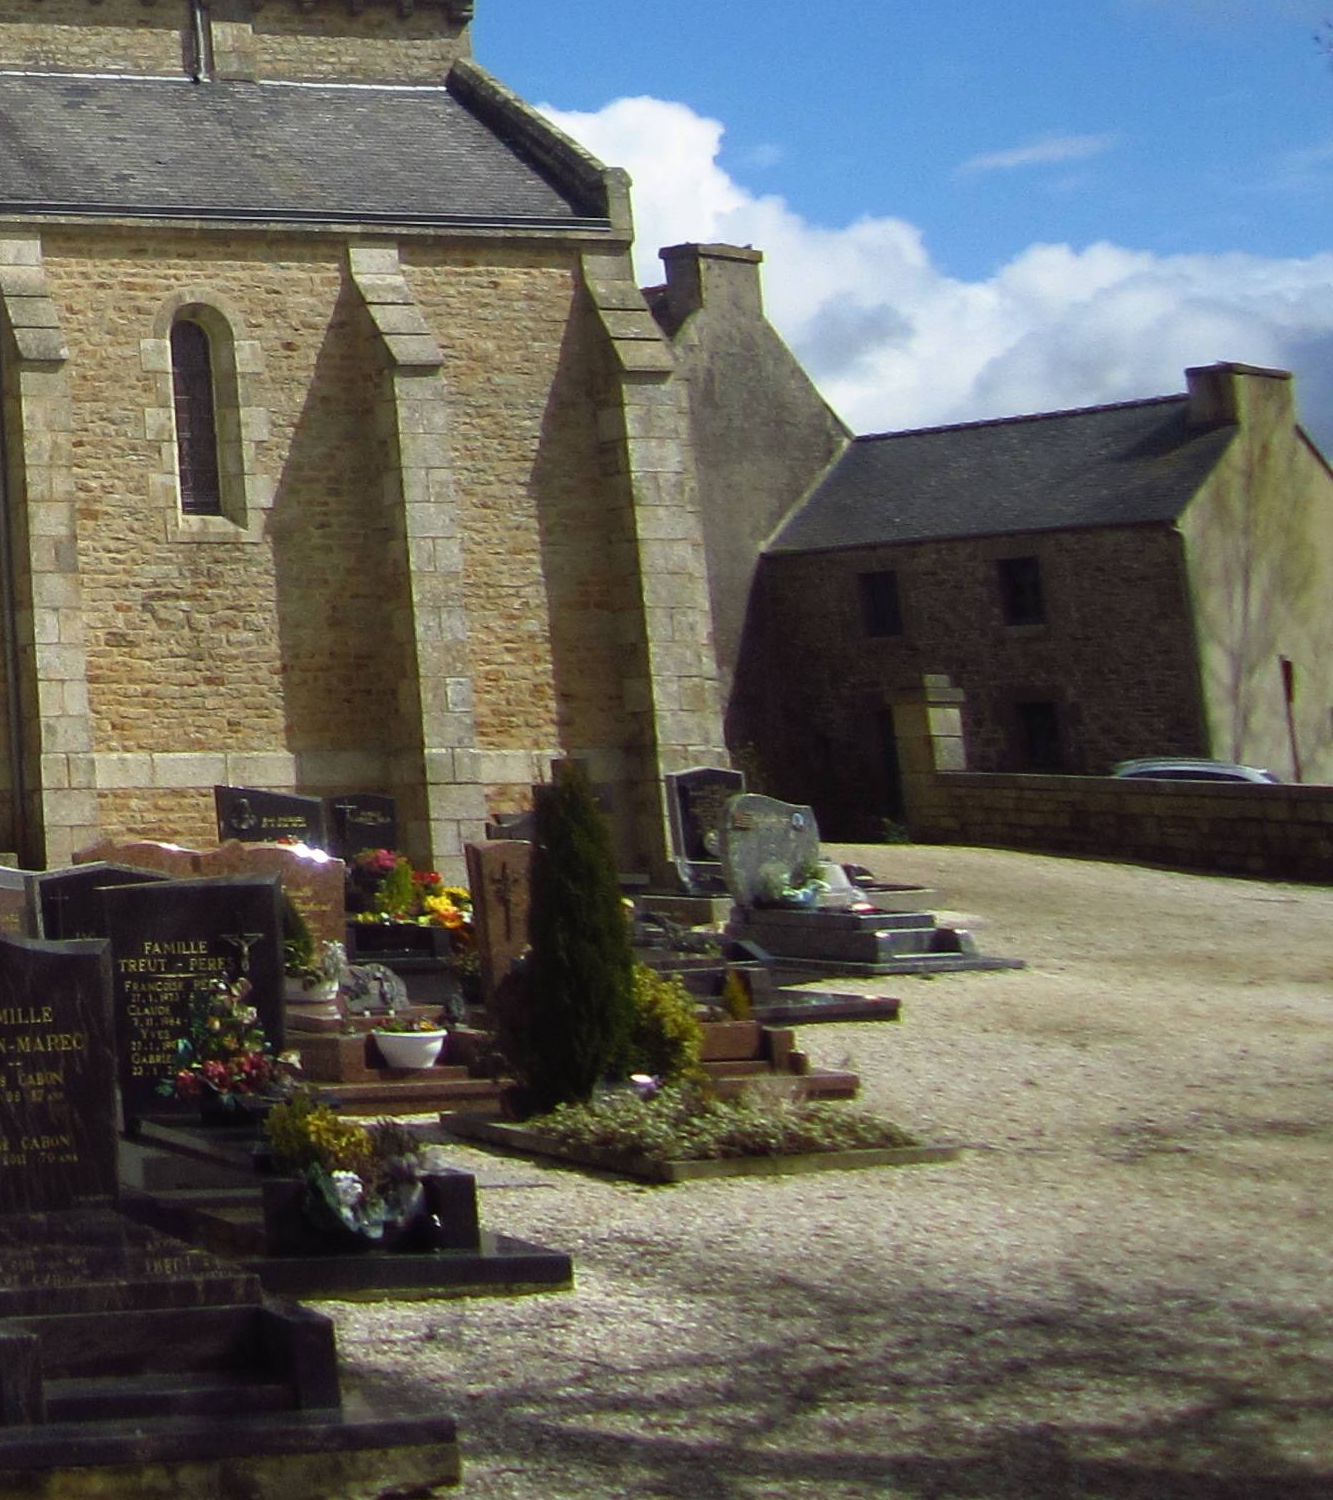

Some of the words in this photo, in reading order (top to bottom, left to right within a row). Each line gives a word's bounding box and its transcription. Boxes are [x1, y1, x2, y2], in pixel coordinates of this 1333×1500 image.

[144, 941, 208, 955] FAMILLE
[118, 959, 167, 973] TREUT
[21, 1134, 71, 1151] CABON
